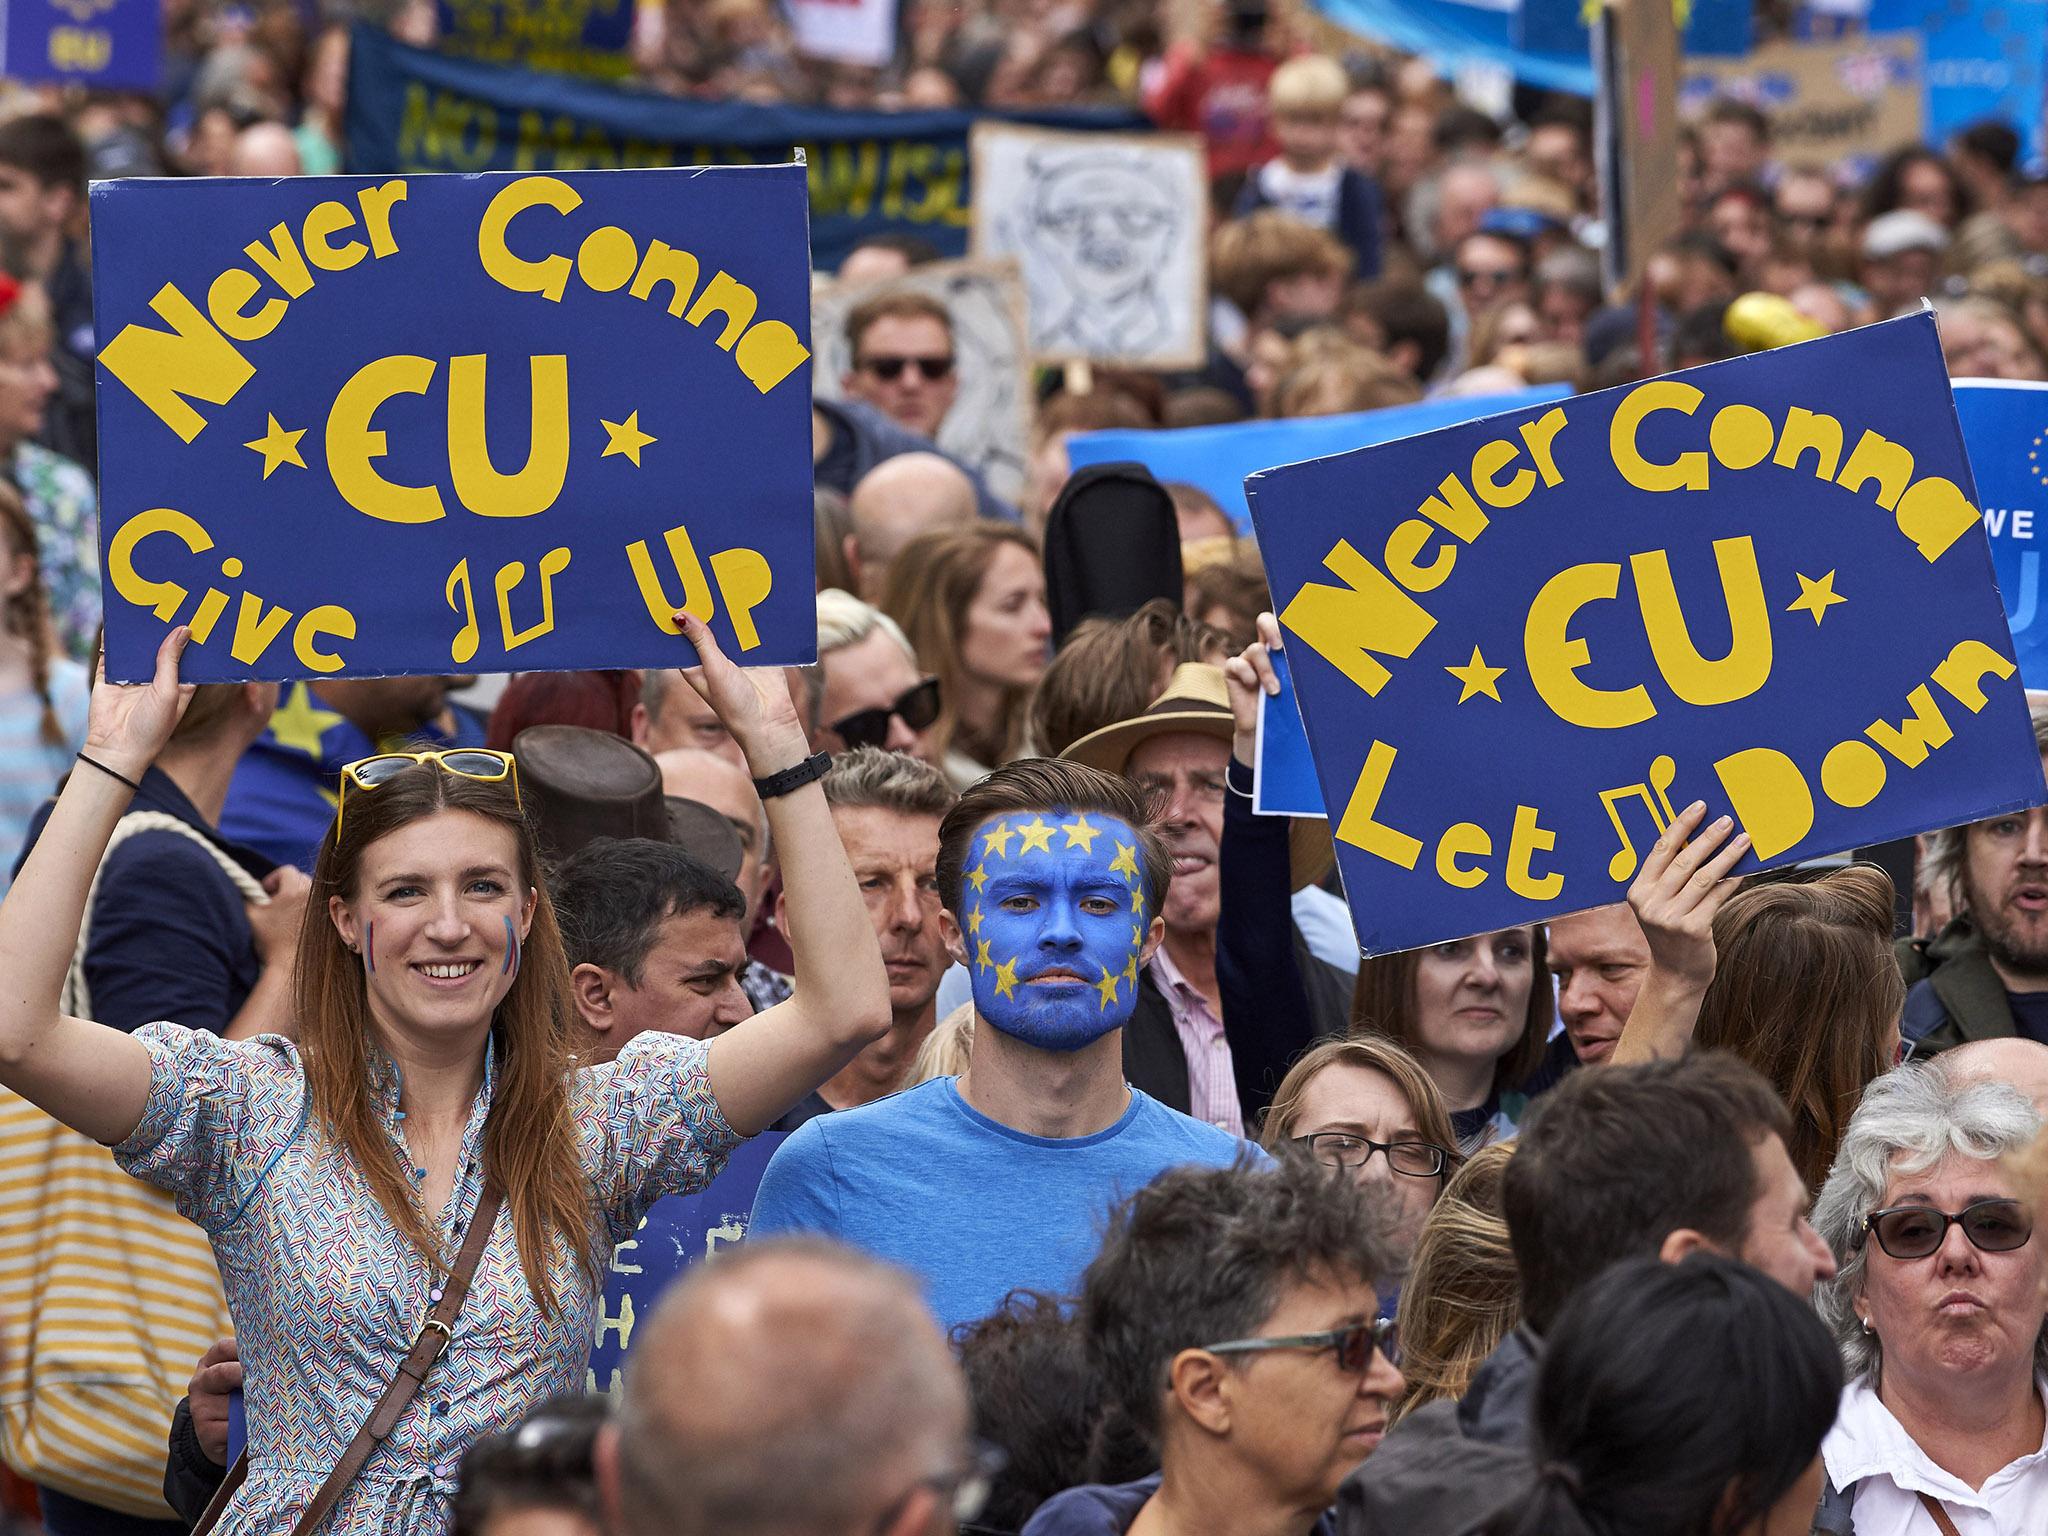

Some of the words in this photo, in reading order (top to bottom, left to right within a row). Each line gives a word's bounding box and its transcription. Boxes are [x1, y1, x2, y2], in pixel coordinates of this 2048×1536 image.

[97, 180, 407, 443] Never
[479, 176, 811, 393] Gonna
[325, 354, 569, 524] EU
[1279, 407, 1567, 697] Never
[1609, 381, 1981, 563] Gonna
[108, 508, 357, 673] Give
[1523, 536, 1773, 729] EU
[1335, 740, 1565, 901] Let
[1714, 640, 2016, 861] Down
